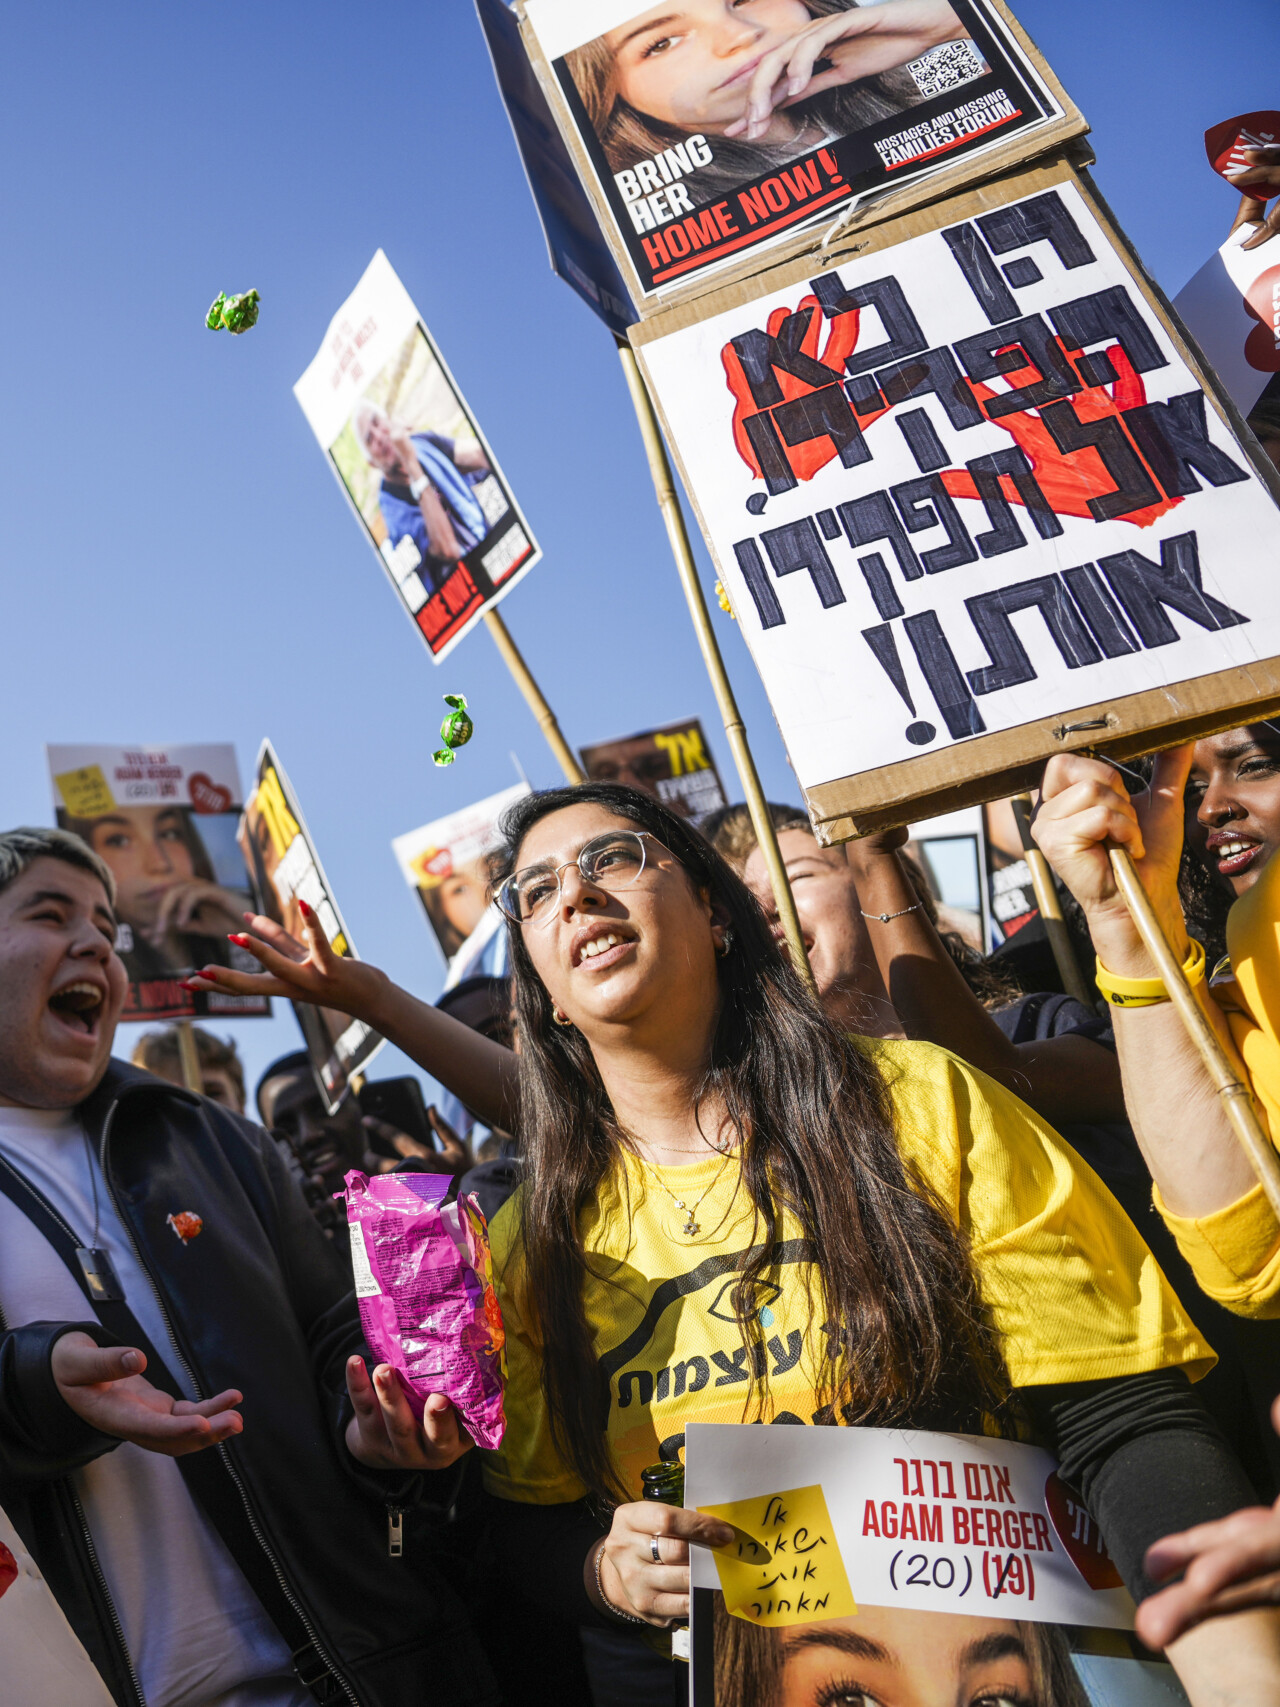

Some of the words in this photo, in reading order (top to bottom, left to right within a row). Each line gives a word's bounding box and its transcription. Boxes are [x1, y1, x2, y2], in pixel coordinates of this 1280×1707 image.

[874, 123, 932, 153] HOSTAGES
[931, 111, 956, 130] AND
[954, 88, 1007, 120] MISSING
[879, 127, 955, 167] FAMILIES
[953, 98, 1017, 138] FORUM
[613, 134, 713, 202] BRING
[627, 182, 696, 235] HER
[641, 200, 740, 270] HOME
[737, 148, 843, 226] NOW!
[941, 190, 1098, 325] הן
[730, 271, 929, 410] לא
[1038, 389, 1252, 524] אל
[860, 531, 1251, 747] אותן!
[654, 728, 710, 777] אל
[618, 1328, 803, 1408] עוצמות
[893, 1457, 957, 1499] ברגר
[963, 1462, 1016, 1504] אגם
[761, 1496, 788, 1526] אל
[862, 1499, 944, 1543] AGAM
[952, 1506, 1054, 1552] BERGER
[751, 1591, 830, 1617] מאחור
[889, 1549, 973, 1597] (20)
